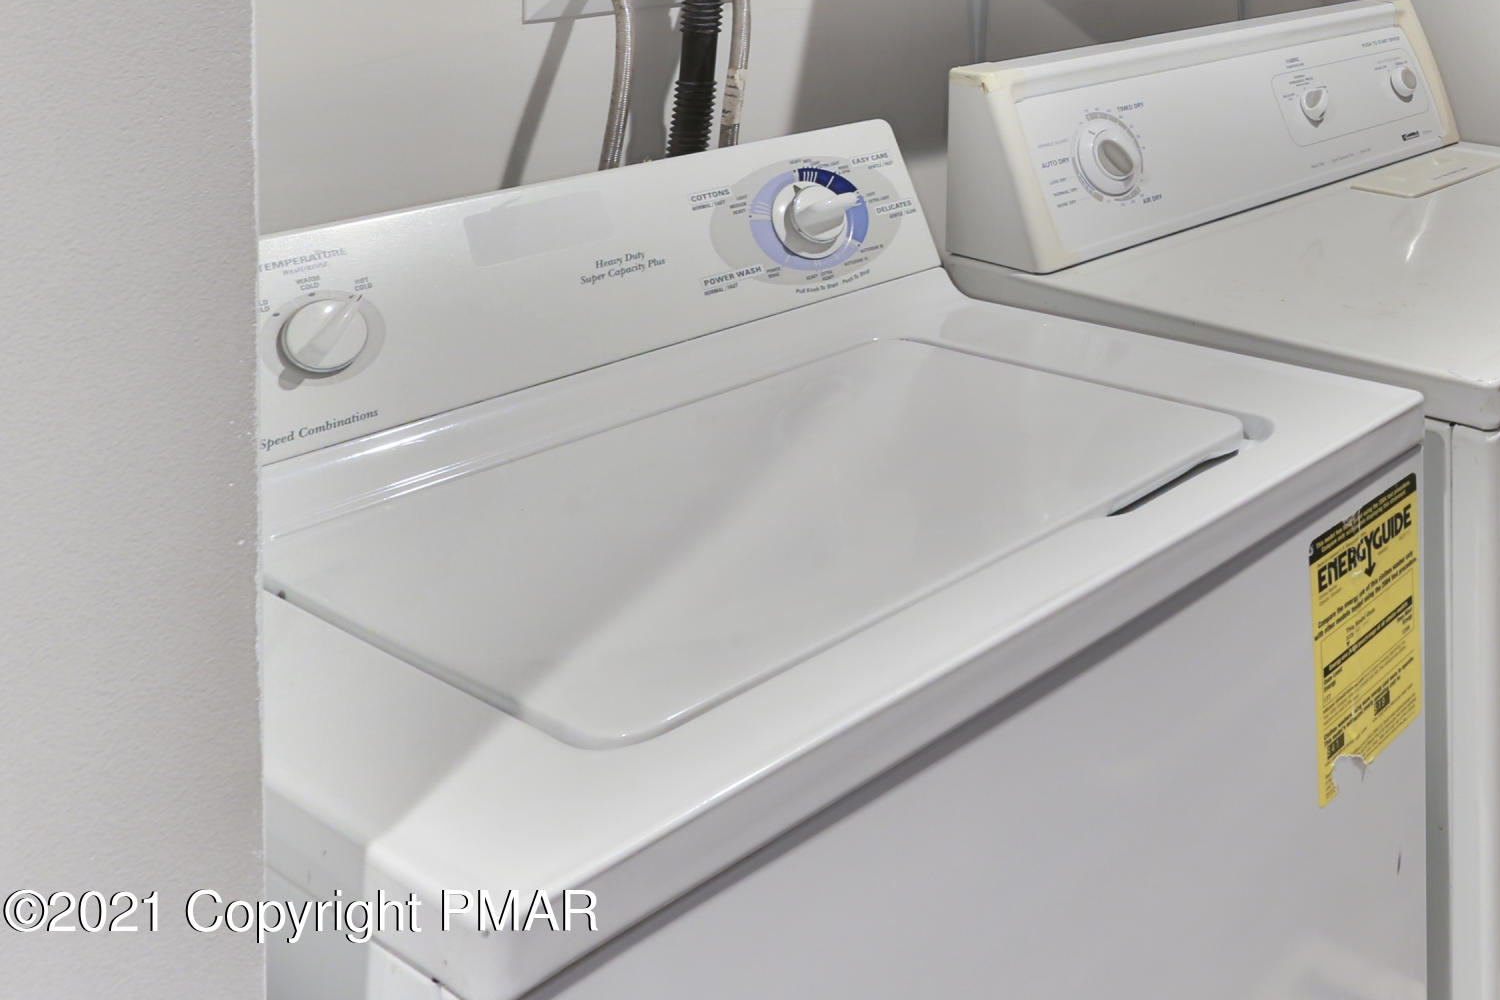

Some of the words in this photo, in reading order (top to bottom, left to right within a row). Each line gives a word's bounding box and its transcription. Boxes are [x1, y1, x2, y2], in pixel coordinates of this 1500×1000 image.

[852, 156, 870, 165] EASY
[871, 152, 889, 161] CARE
[1041, 160, 1057, 169] AUTO
[690, 188, 731, 202] COTTONS
[876, 201, 912, 213] DELICATES
[595, 257, 622, 269] Heavy
[625, 251, 645, 262] Duty
[580, 273, 606, 285] Super
[608, 263, 645, 278] Capacity
[648, 258, 665, 268] Plus
[703, 272, 736, 287] POWER
[736, 265, 762, 278] WASH
[260, 430, 295, 451] Speed
[298, 408, 379, 438] Combinations
[1317, 503, 1412, 593] ENERGYGUIDE
